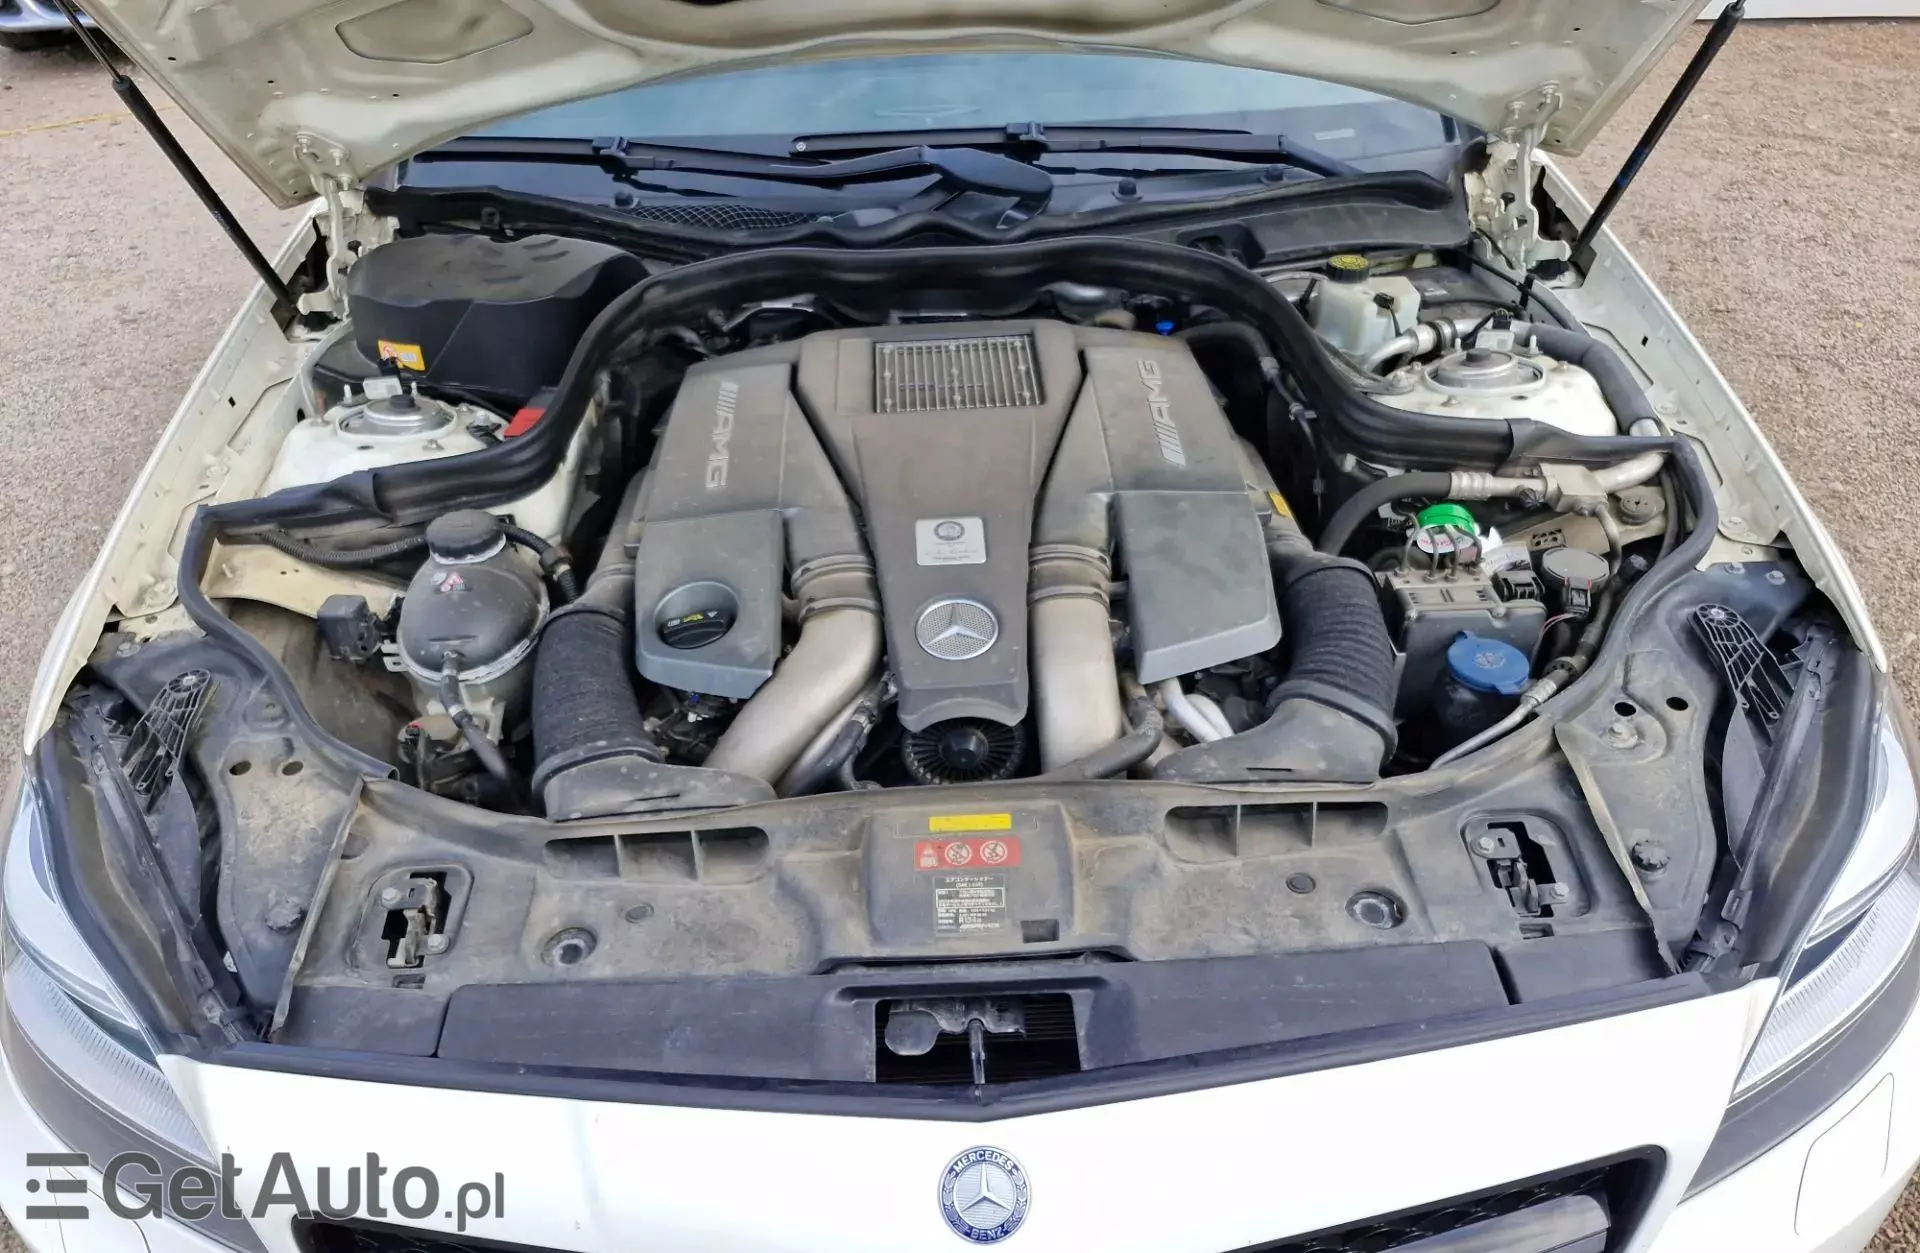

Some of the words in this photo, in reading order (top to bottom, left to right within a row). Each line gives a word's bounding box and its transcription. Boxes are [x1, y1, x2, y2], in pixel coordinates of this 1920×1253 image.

[1136, 359, 1177, 432] AMG
[705, 412, 735, 488] AMG
[953, 1150, 1015, 1173] MERCEDES
[970, 1227, 1005, 1241] BENZ
